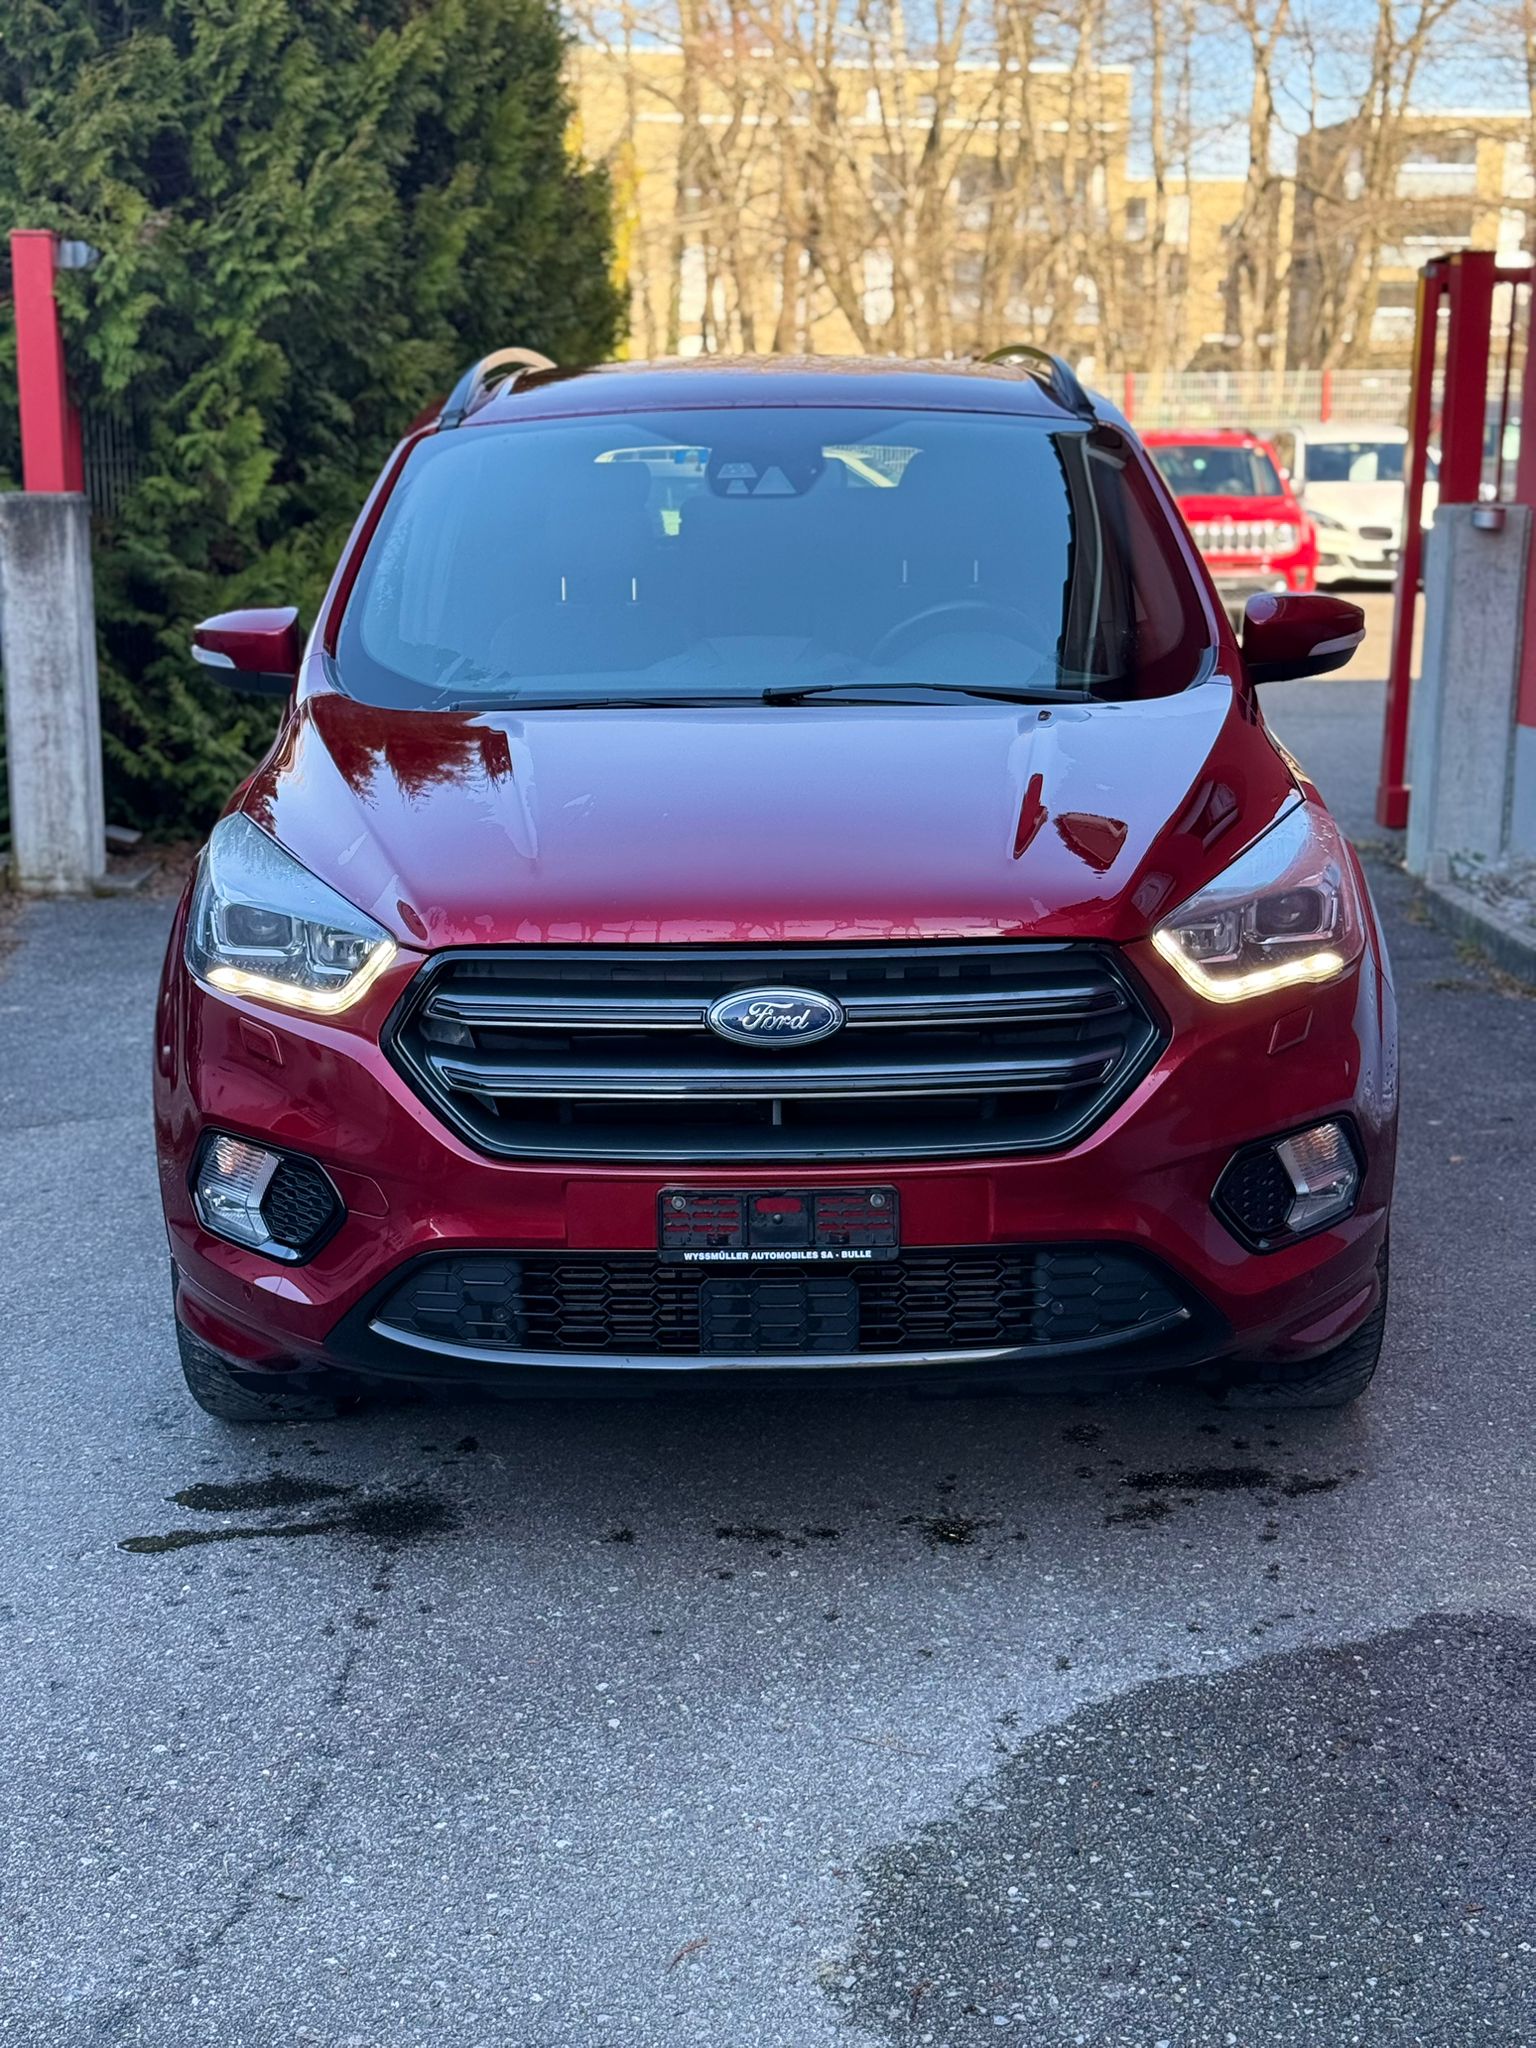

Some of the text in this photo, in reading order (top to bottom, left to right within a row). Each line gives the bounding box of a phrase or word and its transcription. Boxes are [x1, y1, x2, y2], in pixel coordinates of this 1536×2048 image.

[741, 1001, 811, 1031] Ford
[683, 1250, 749, 1260] WYSSMÜLLER
[751, 1251, 819, 1260] AUTOMOBILES
[820, 1250, 834, 1259] SA
[841, 1250, 872, 1259] BULLE
